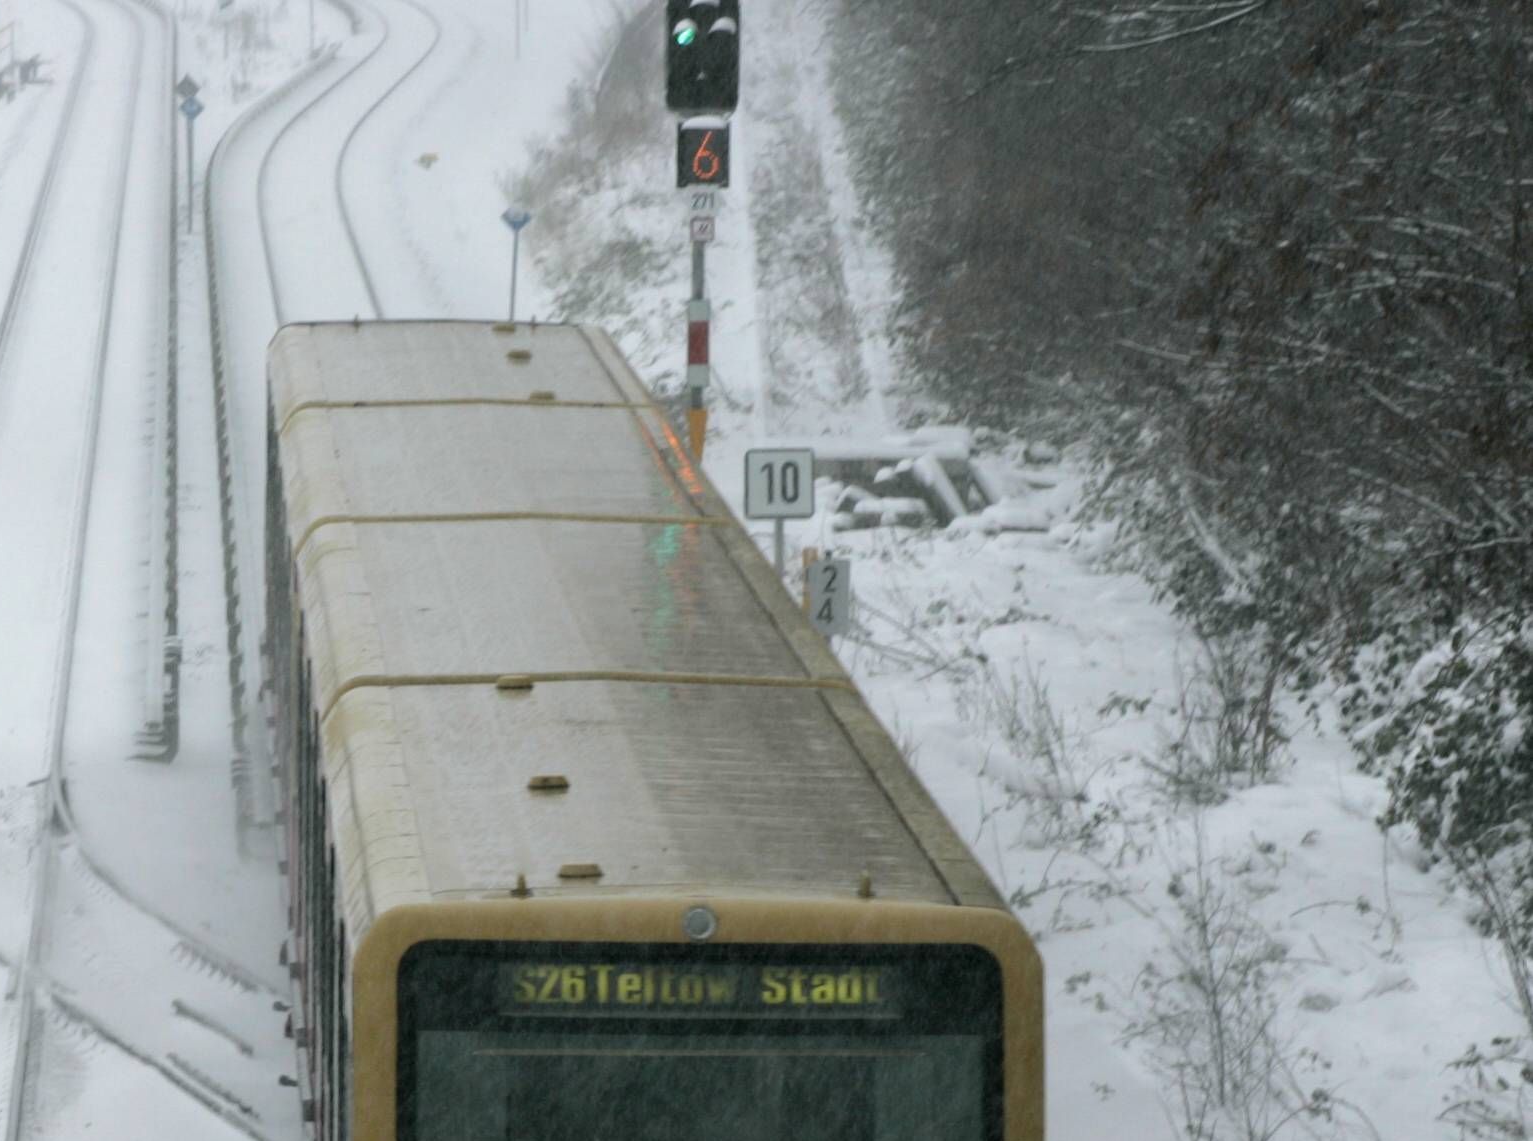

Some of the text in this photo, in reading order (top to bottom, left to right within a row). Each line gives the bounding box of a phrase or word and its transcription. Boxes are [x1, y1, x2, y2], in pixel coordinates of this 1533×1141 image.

[692, 130, 719, 180] 6
[760, 460, 800, 505] 10
[821, 565, 838, 593] 2
[817, 598, 834, 624] 4
[514, 963, 586, 1004] S26
